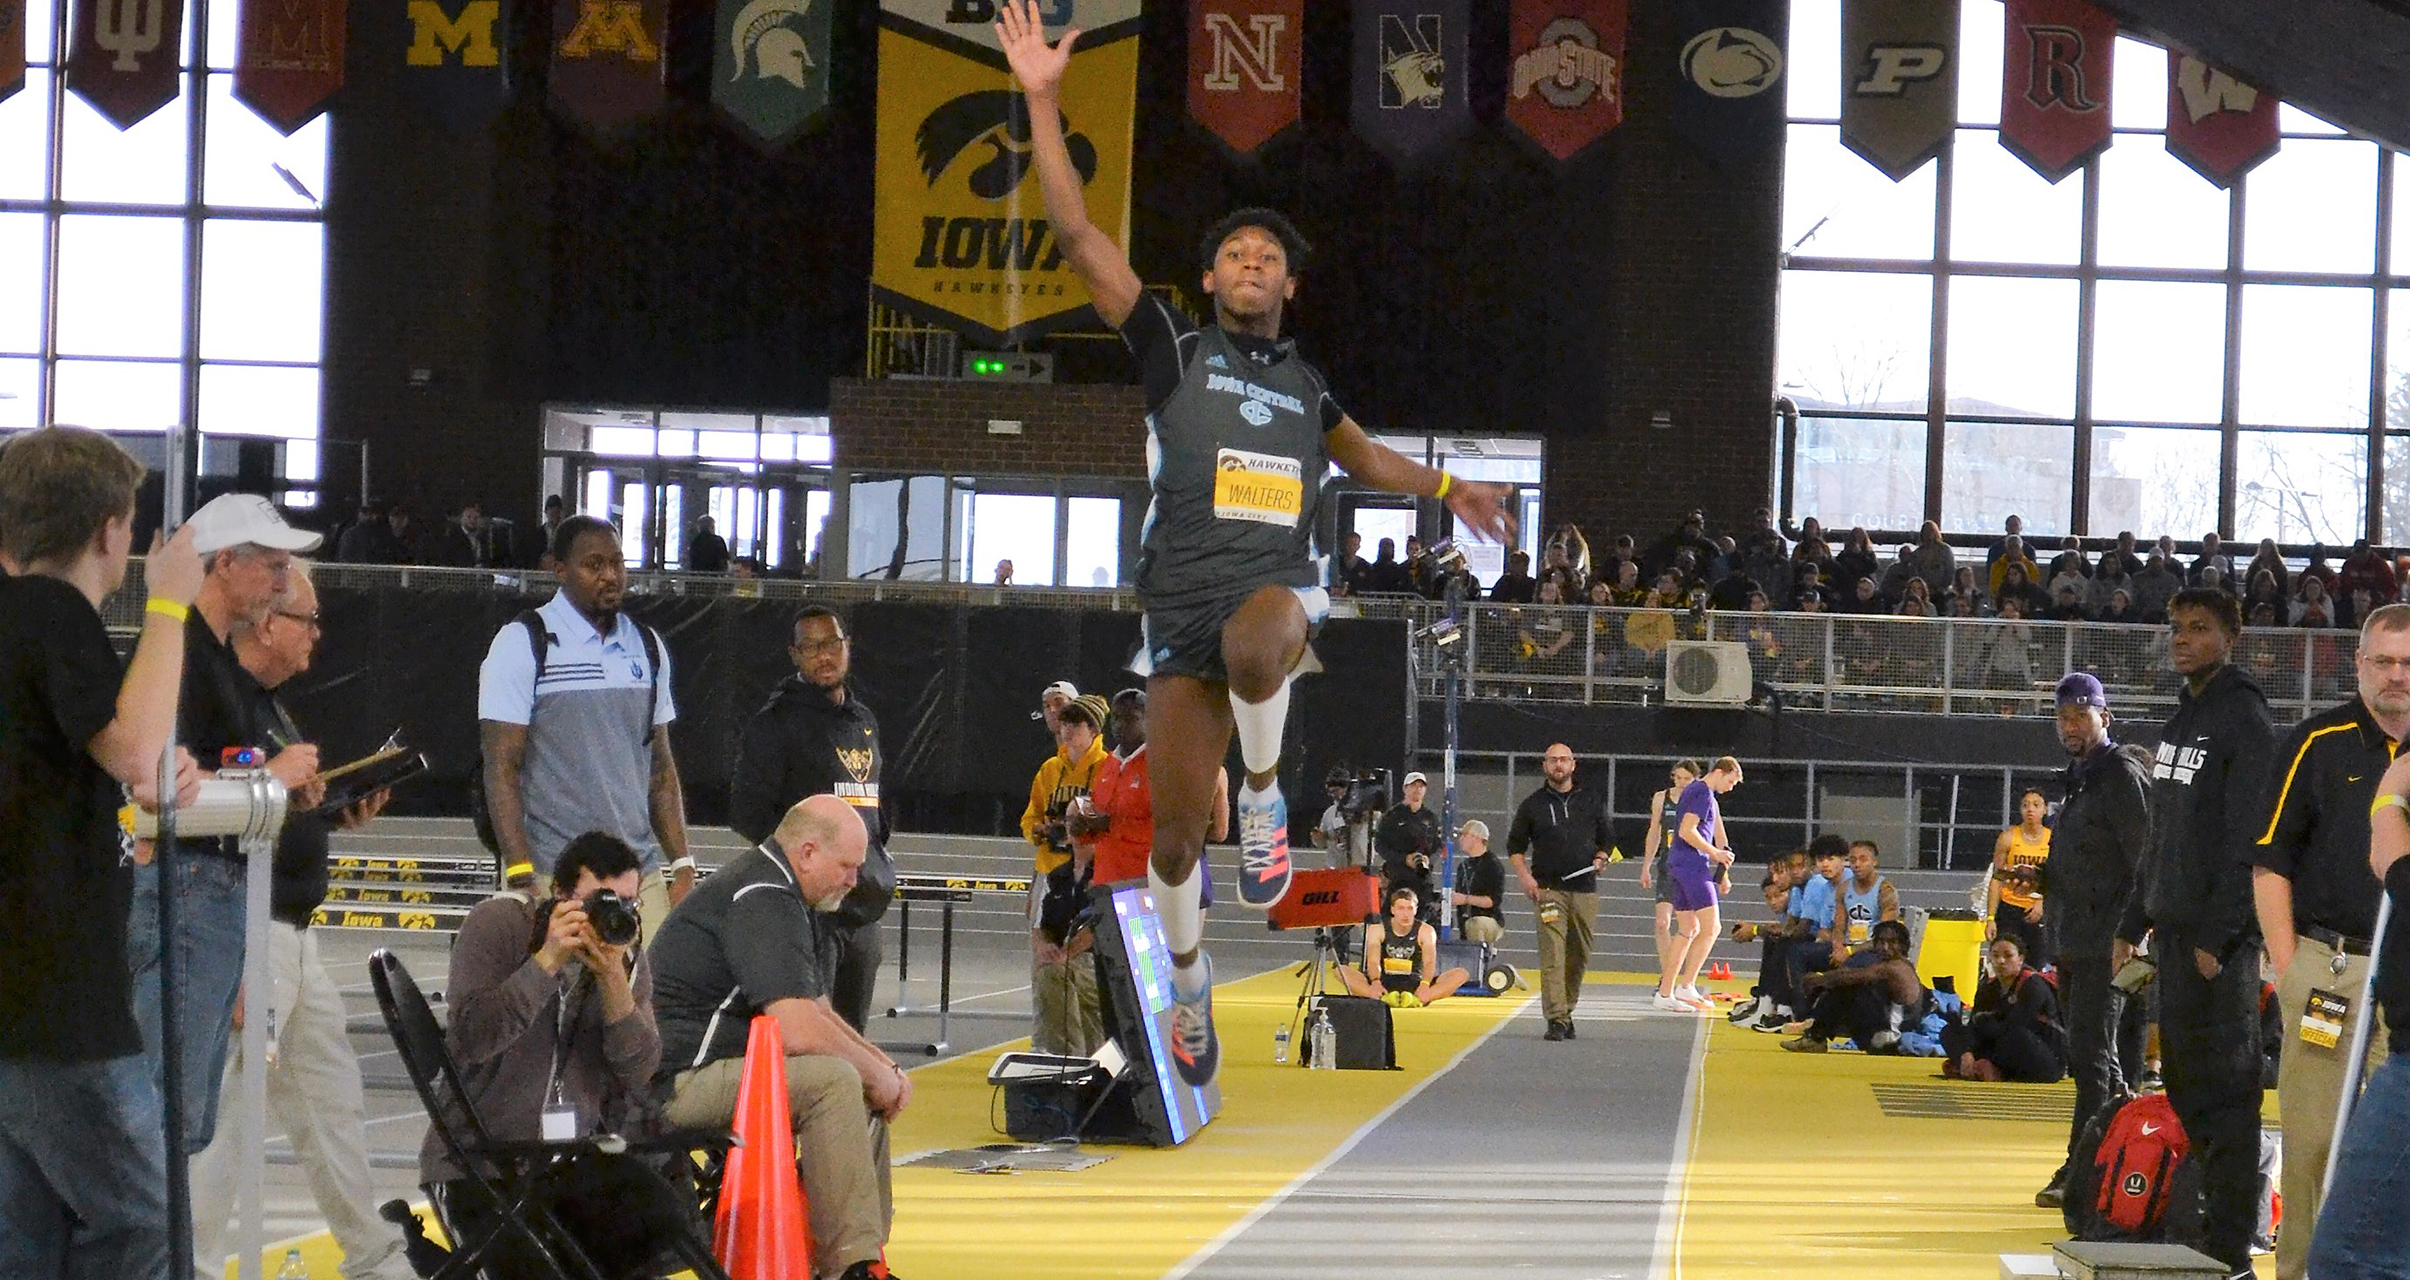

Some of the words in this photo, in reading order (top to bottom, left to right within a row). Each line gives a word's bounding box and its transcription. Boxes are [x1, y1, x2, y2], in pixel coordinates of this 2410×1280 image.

[406, 0, 500, 67] M
[1203, 13, 1286, 91] N
[1854, 45, 1946, 95] P
[2022, 26, 2099, 114] R
[933, 280, 1065, 297] HAWKEYES
[1205, 373, 1246, 396] IOWA
[1228, 484, 1294, 510] WALTERS
[341, 910, 385, 928] Iowa
